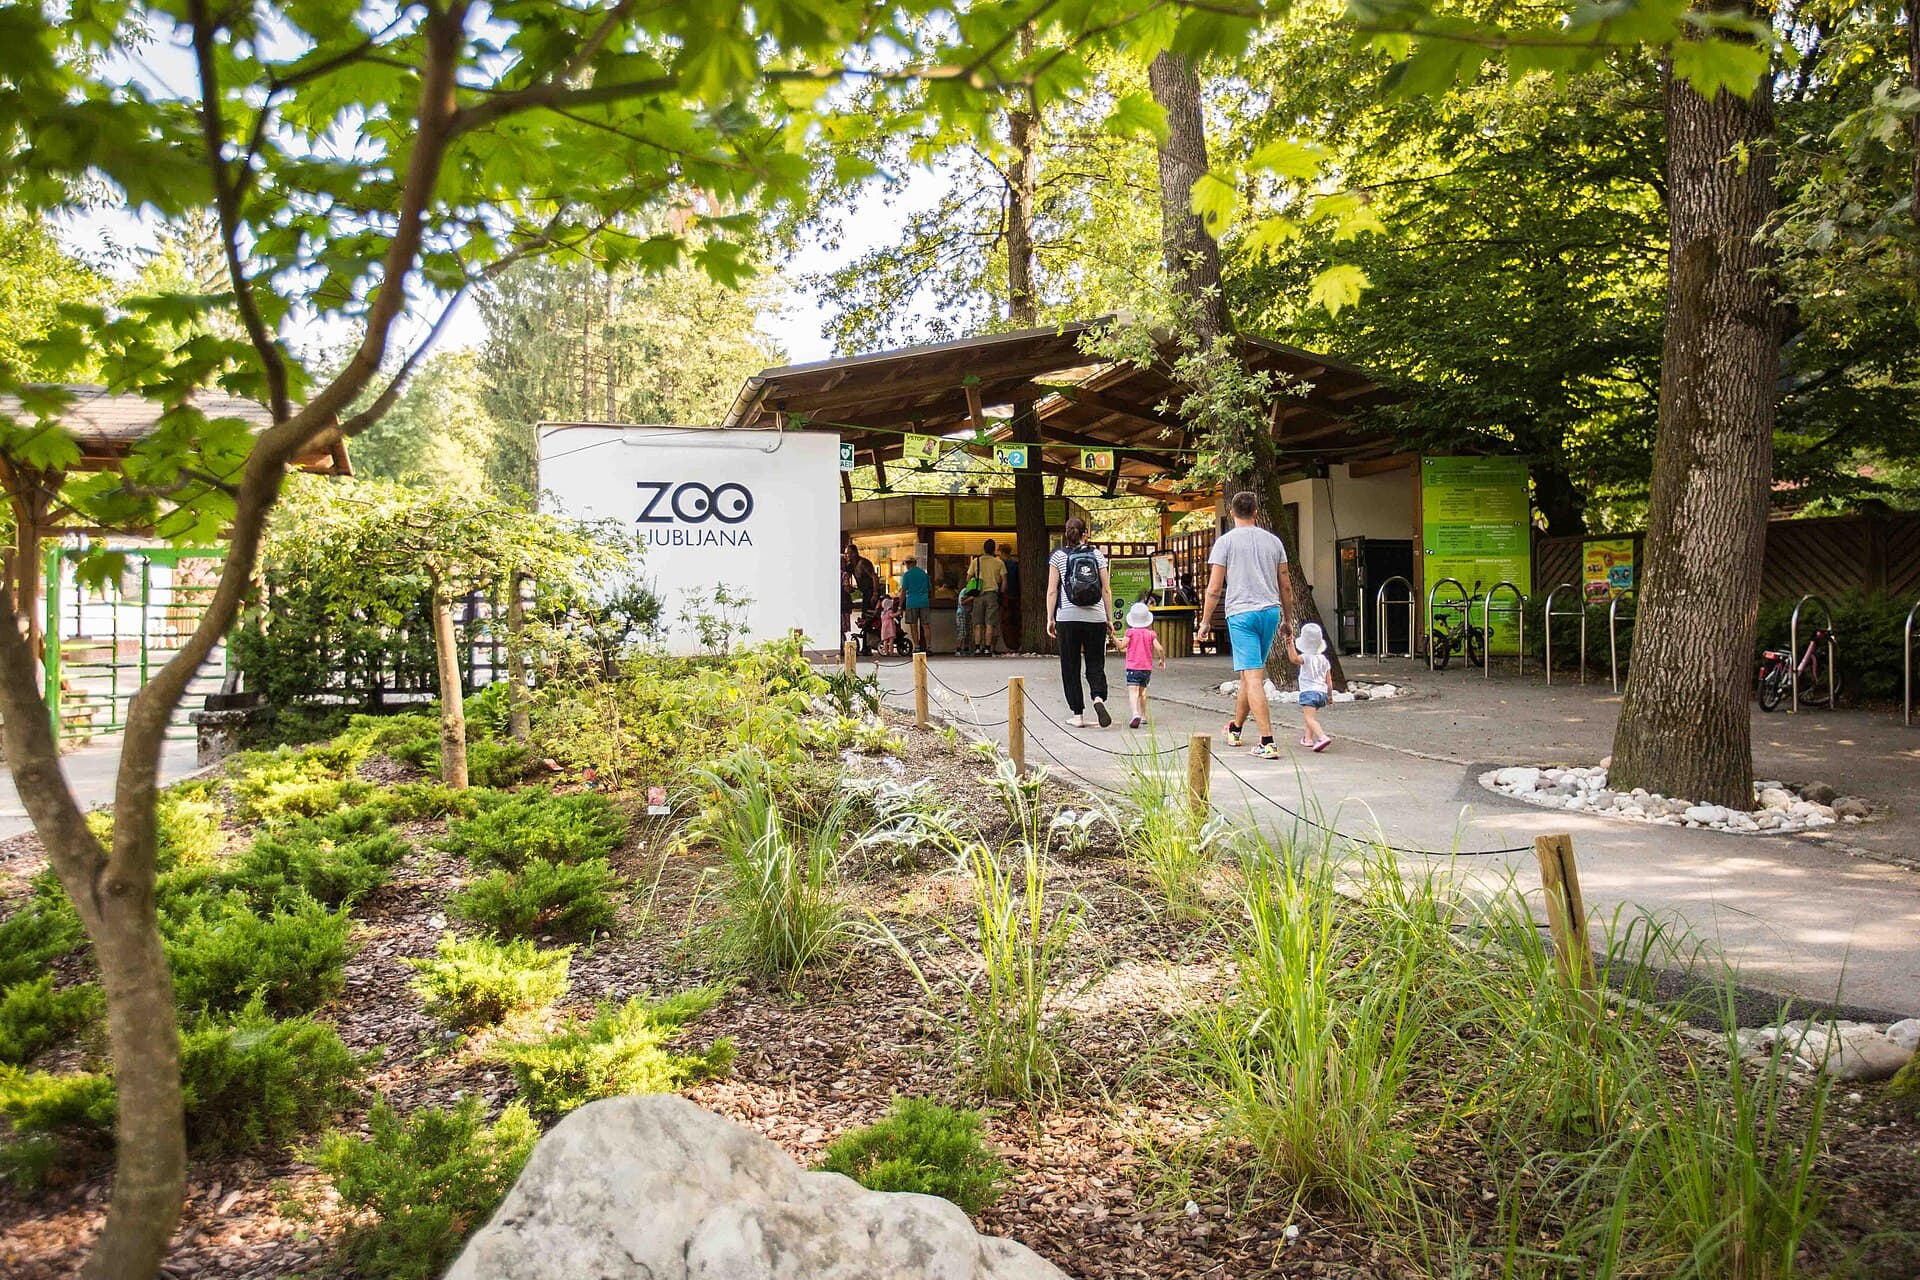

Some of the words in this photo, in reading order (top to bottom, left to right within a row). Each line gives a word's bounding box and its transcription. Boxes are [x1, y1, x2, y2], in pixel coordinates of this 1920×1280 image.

[1013, 453, 1021, 463] 2
[1100, 456, 1106, 466] 1
[635, 481, 754, 524] ZOO
